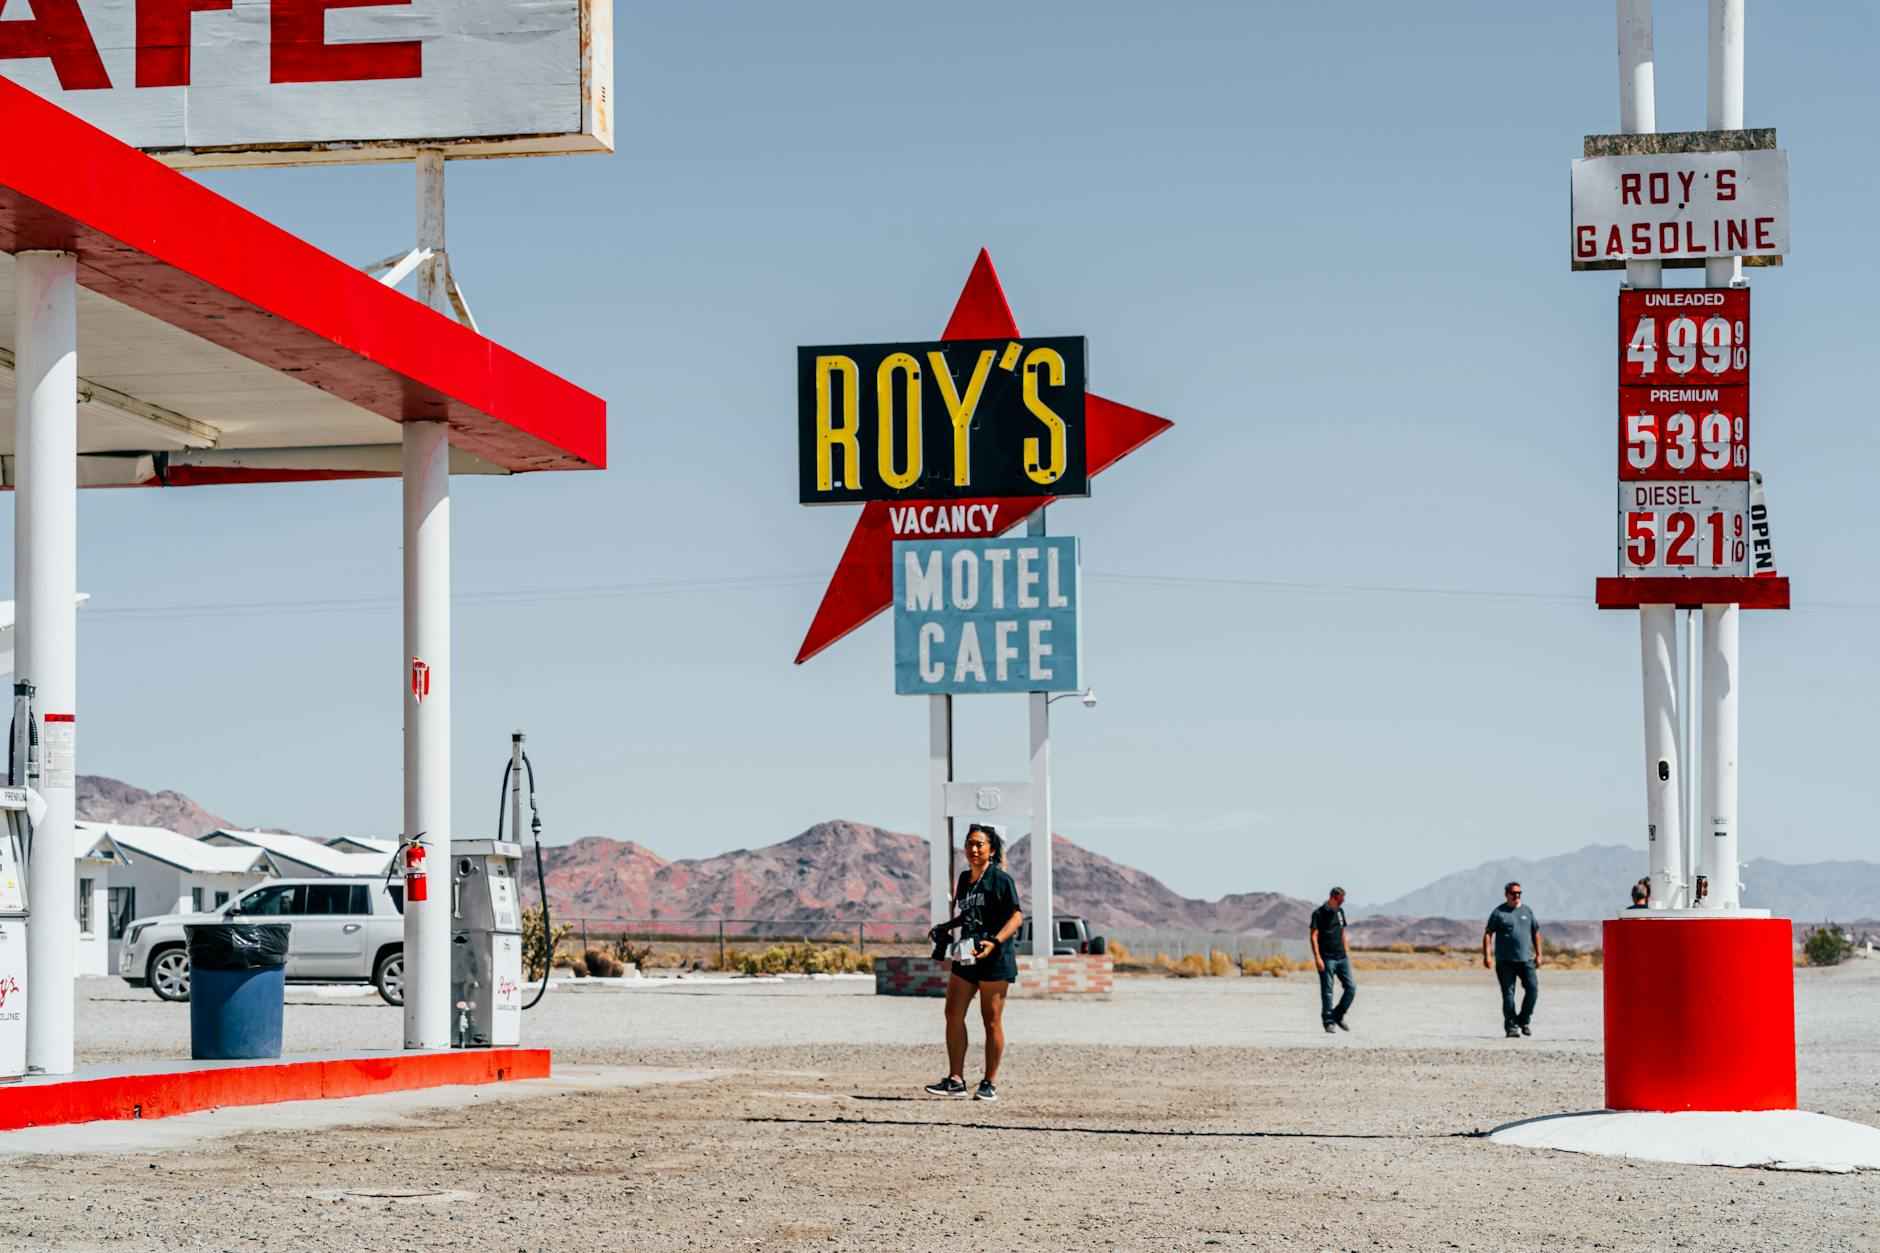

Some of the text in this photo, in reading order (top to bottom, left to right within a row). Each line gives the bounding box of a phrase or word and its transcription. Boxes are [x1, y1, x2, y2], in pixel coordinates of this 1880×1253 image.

[1621, 169, 1737, 205] ROY'S
[1577, 217, 1776, 257] GASOLINE
[1645, 293, 1724, 306] UNLEADED
[1650, 390, 1719, 402] PREMIUM
[815, 341, 1068, 491] ROY'S
[1635, 485, 1701, 506] DIESEL
[889, 504, 999, 534] VACANCY
[1751, 504, 1773, 569] OPEN
[905, 547, 1068, 611] MOTEL
[919, 619, 1053, 683] CAFE
